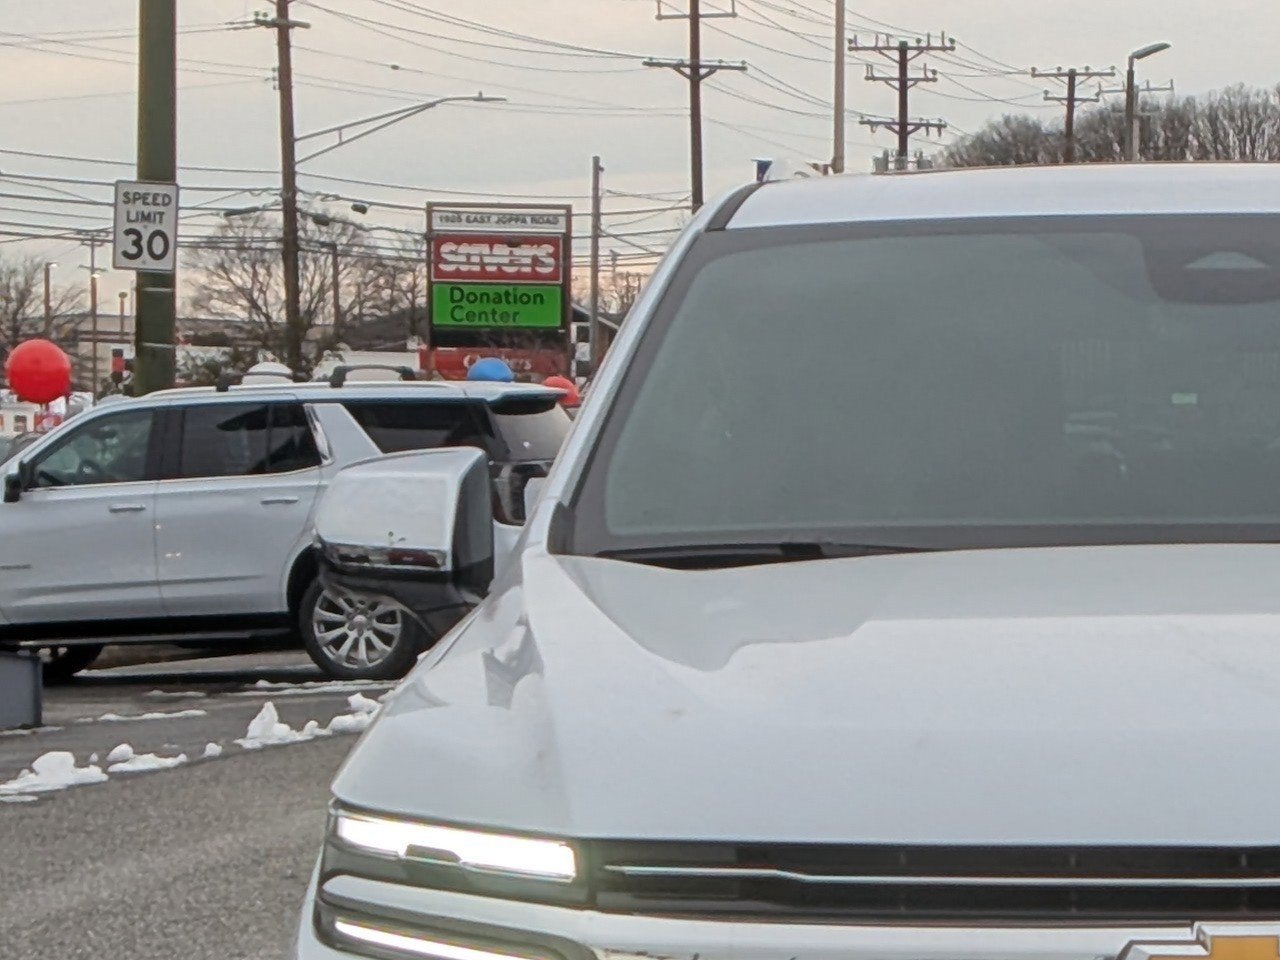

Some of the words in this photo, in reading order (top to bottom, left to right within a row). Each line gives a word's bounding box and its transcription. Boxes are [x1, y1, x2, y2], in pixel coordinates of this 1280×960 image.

[122, 190, 172, 207] SPEED
[126, 210, 165, 224] LIMIT
[465, 214, 492, 225] EAST
[495, 214, 527, 226] JOPPA
[530, 215, 560, 226] ROAD
[121, 227, 170, 261] 30
[449, 286, 545, 306] Donation
[450, 304, 520, 323] Center
